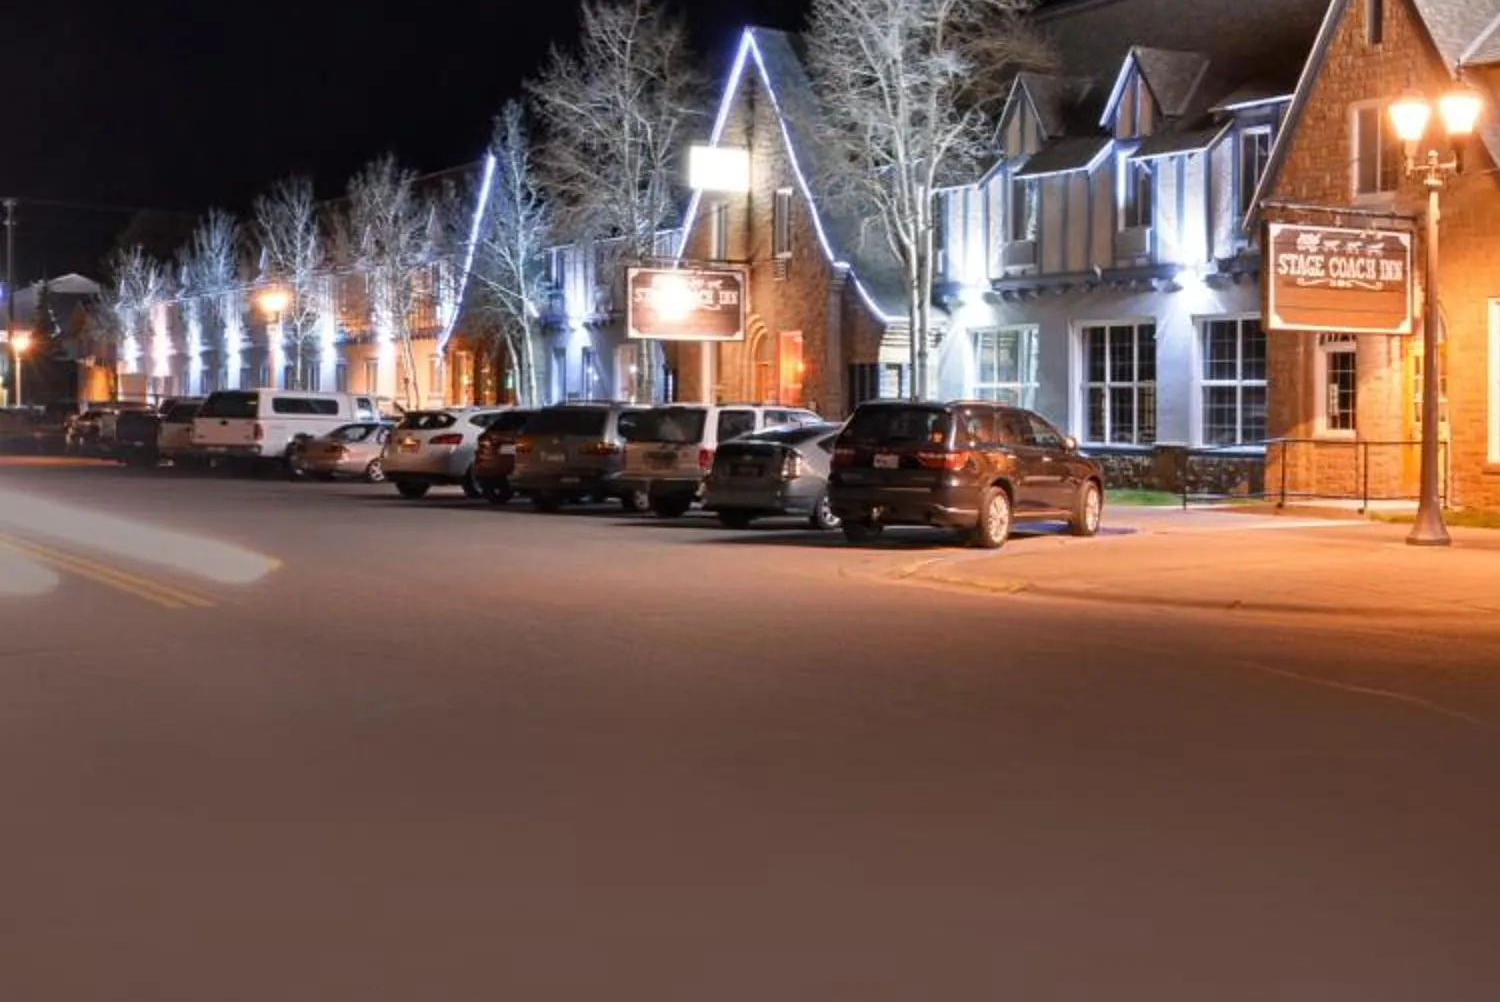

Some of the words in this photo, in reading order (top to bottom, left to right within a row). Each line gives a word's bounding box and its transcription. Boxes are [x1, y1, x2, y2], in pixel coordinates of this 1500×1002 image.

[1278, 253, 1325, 277] STAGE
[1328, 256, 1377, 280] COACH
[1379, 259, 1403, 281] INN
